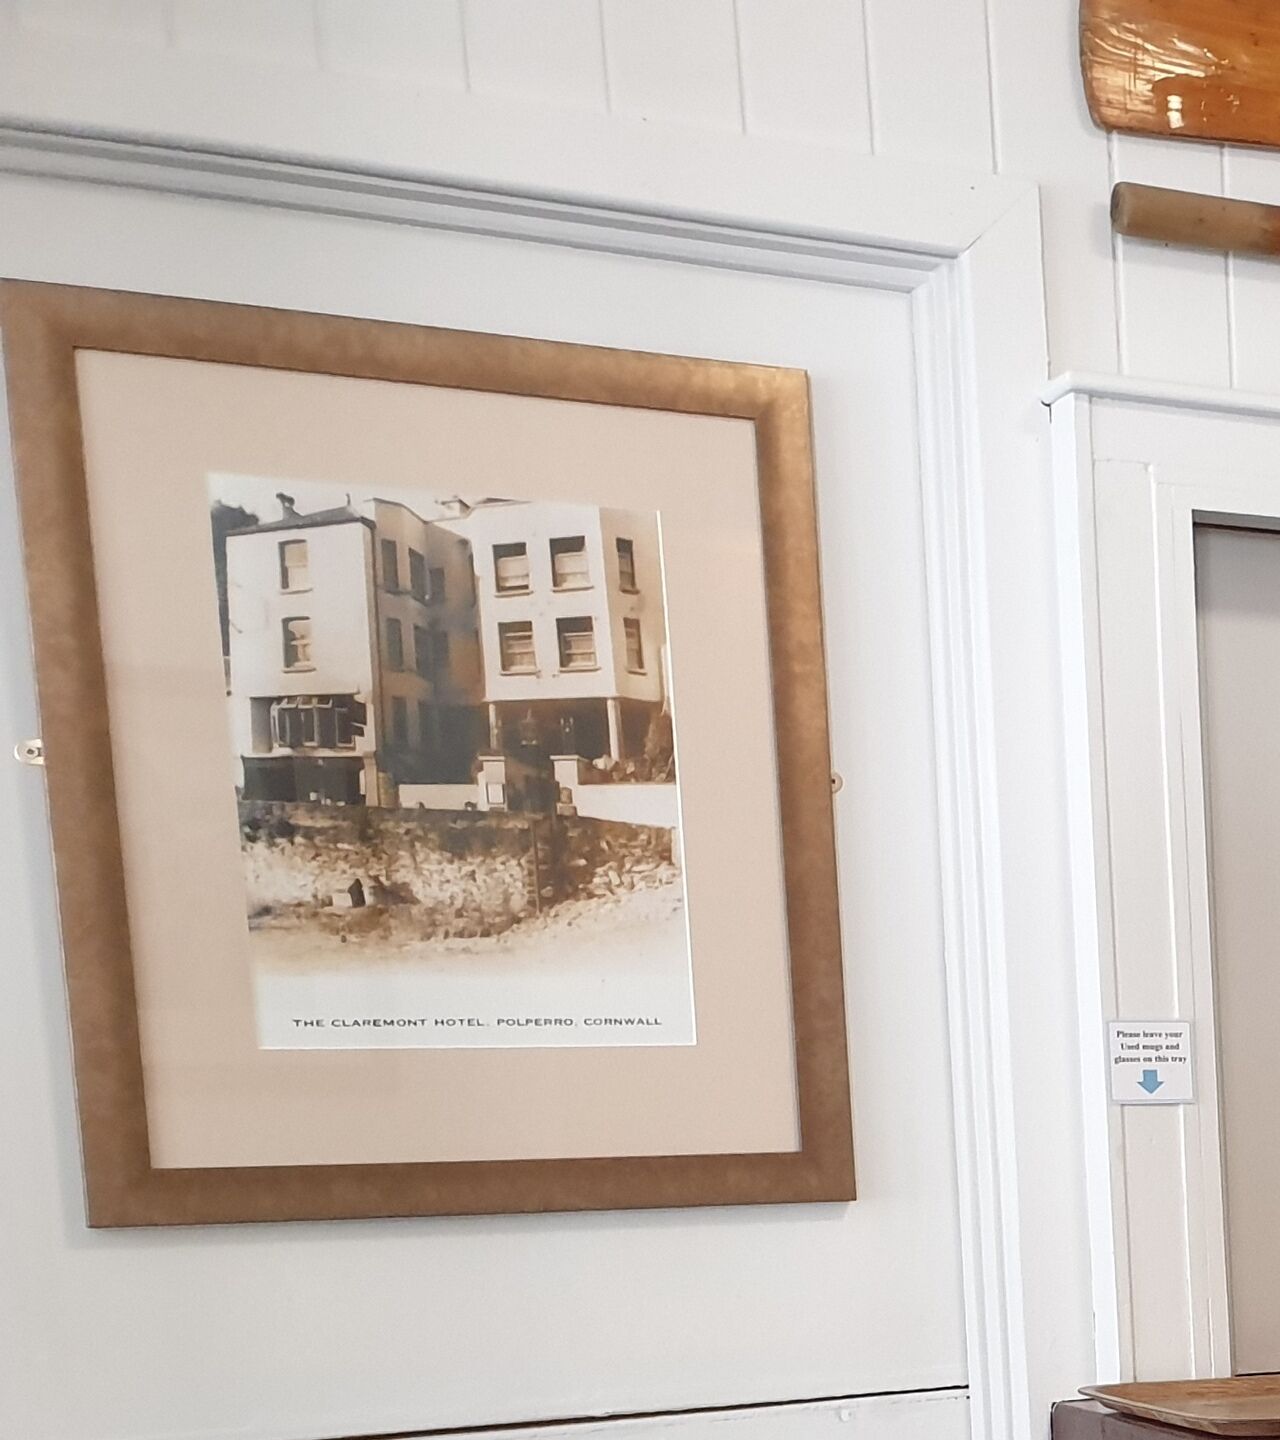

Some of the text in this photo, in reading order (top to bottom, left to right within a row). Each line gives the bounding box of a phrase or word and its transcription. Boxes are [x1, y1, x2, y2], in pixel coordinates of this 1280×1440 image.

[292, 1019, 325, 1027] THE
[331, 1018, 427, 1027] CLAREMONT
[583, 1017, 663, 1026] CORNWALL
[1116, 1030, 1183, 1040] Please leave your
[1114, 1056, 1141, 1064] glasses
[1171, 1056, 1187, 1064] tray
